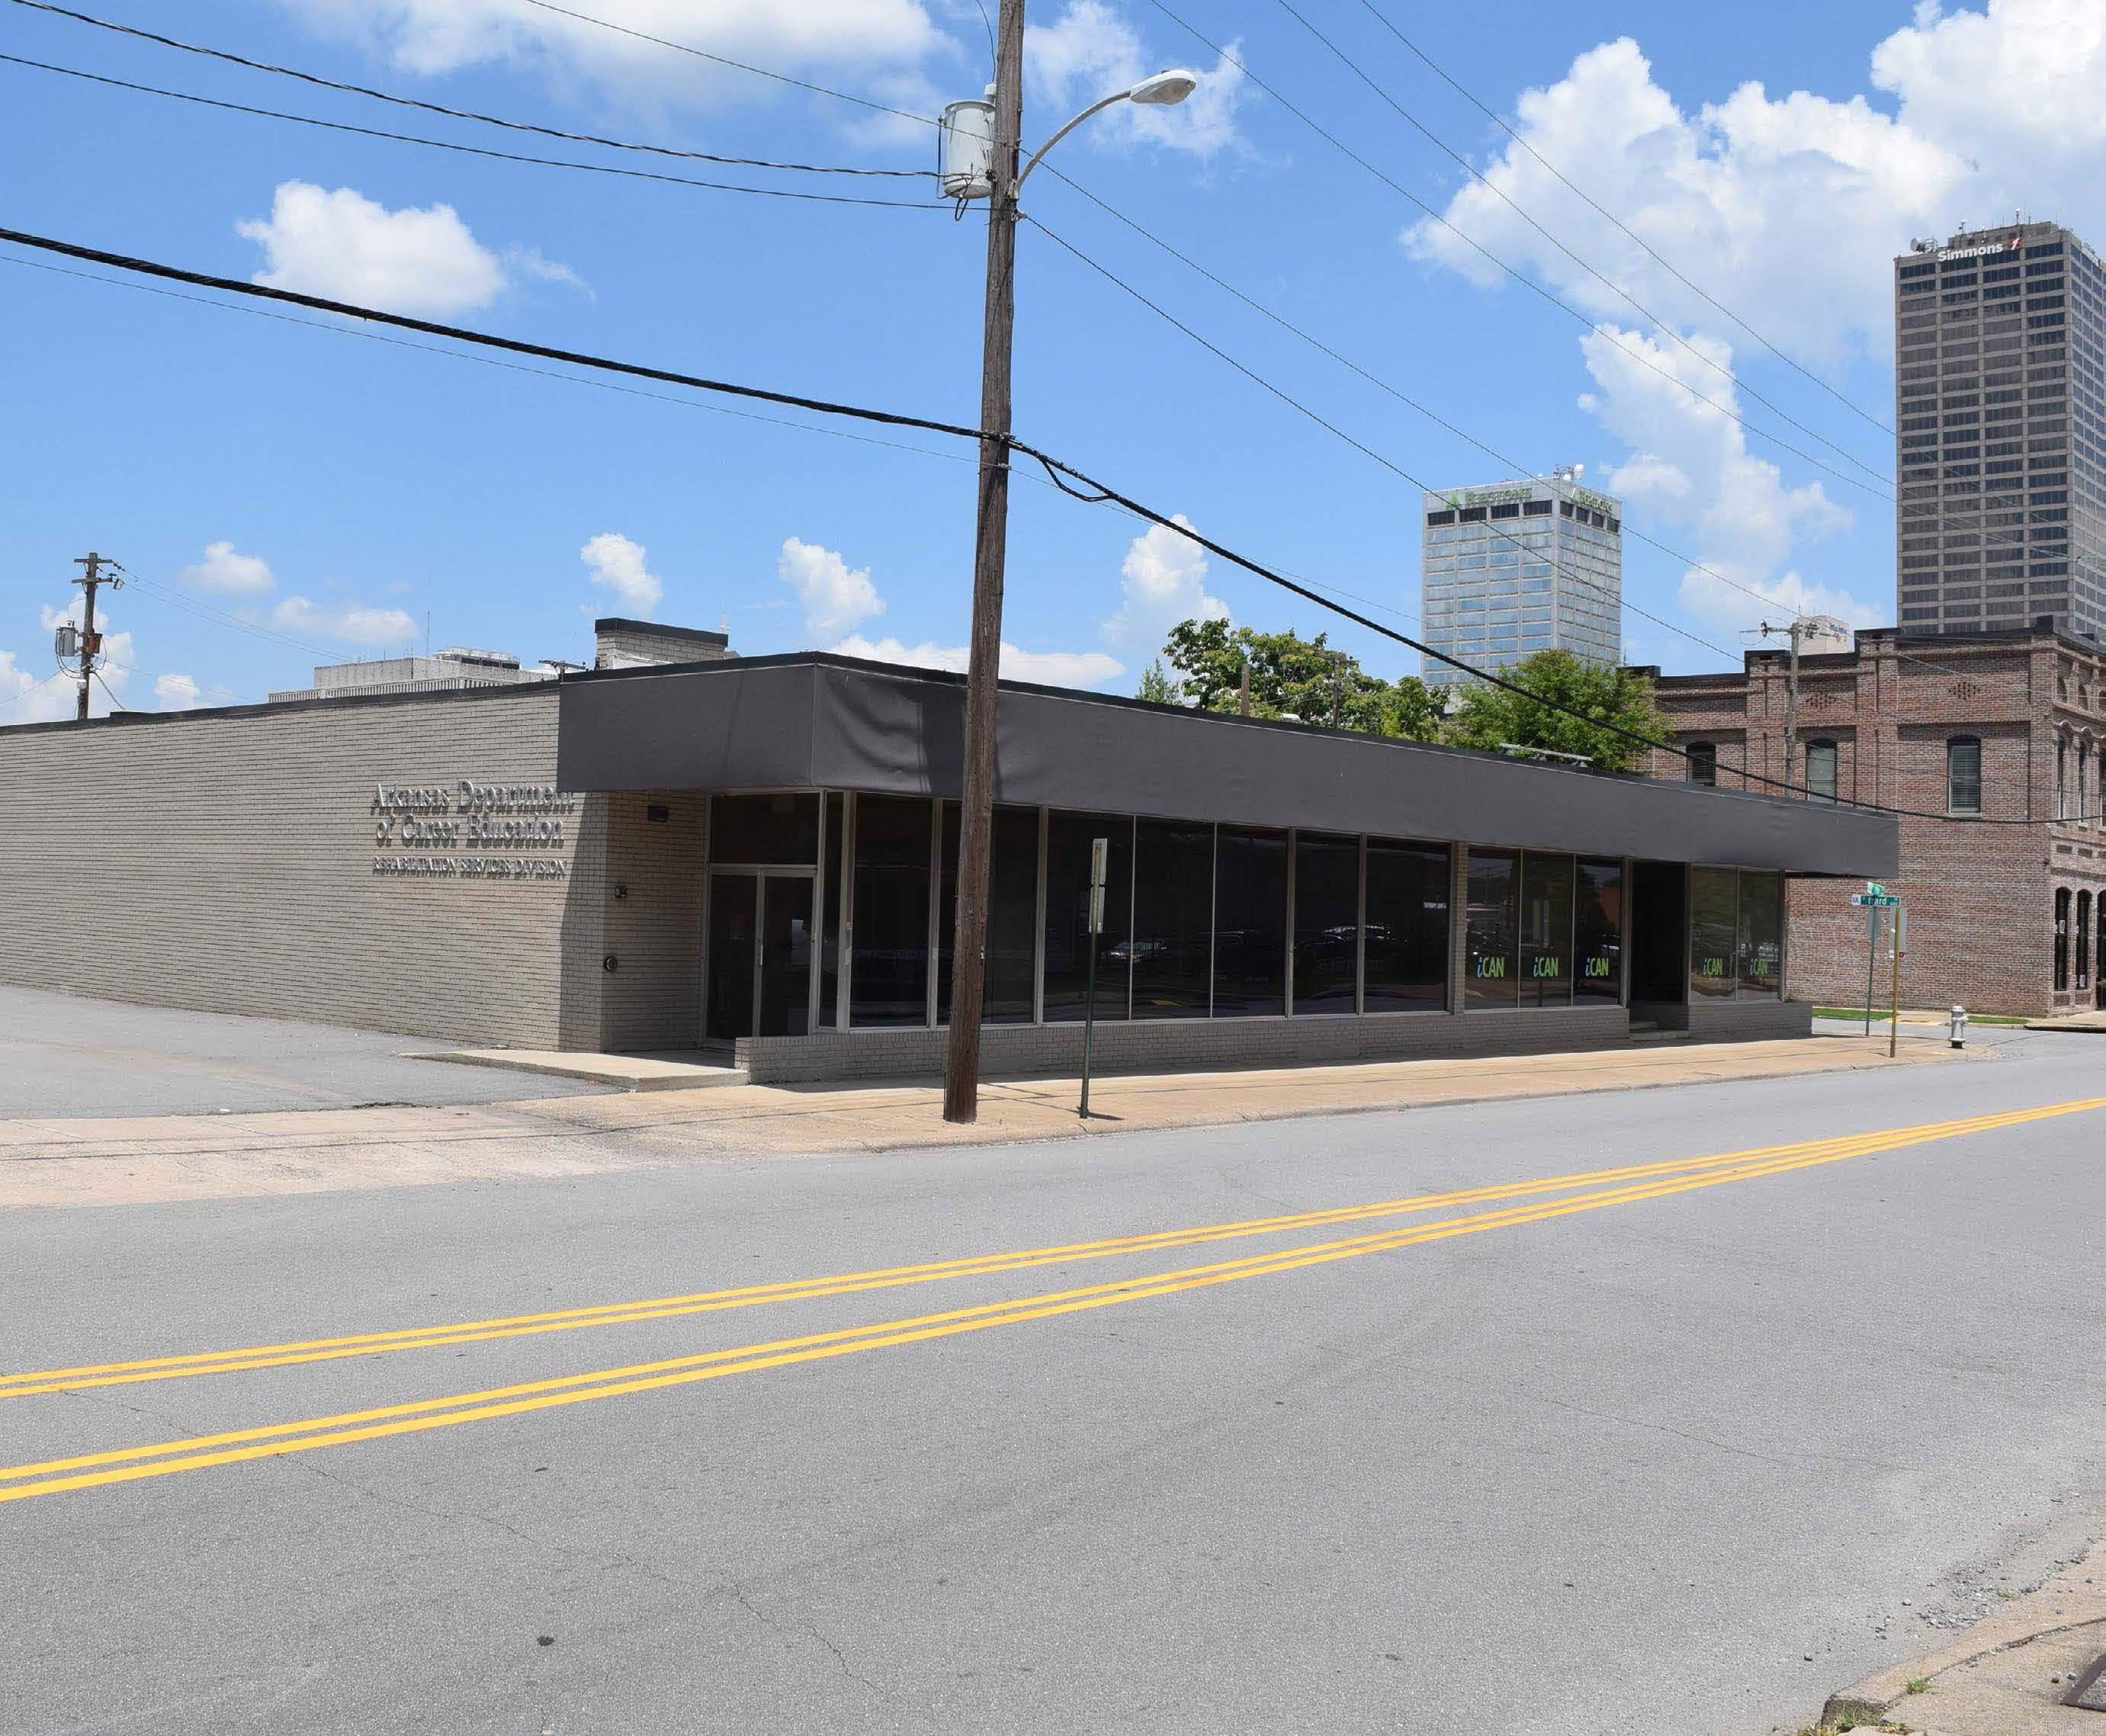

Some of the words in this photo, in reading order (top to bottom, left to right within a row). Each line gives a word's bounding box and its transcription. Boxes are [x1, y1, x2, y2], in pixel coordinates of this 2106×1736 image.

[1937, 243, 2004, 262] Simmons
[371, 781, 450, 807] Arkansas
[457, 778, 575, 810] Department
[377, 813, 396, 839] of
[402, 813, 460, 839] Career
[467, 809, 564, 839] Education
[460, 858, 512, 872] SERVICES
[516, 858, 565, 874] DIVISION
[1477, 956, 1504, 977] iCAN
[1533, 956, 1559, 977] iCAN
[1585, 957, 1609, 977] iCAN
[1703, 958, 1722, 976] iCAN
[1750, 958, 1767, 975] iCAN
